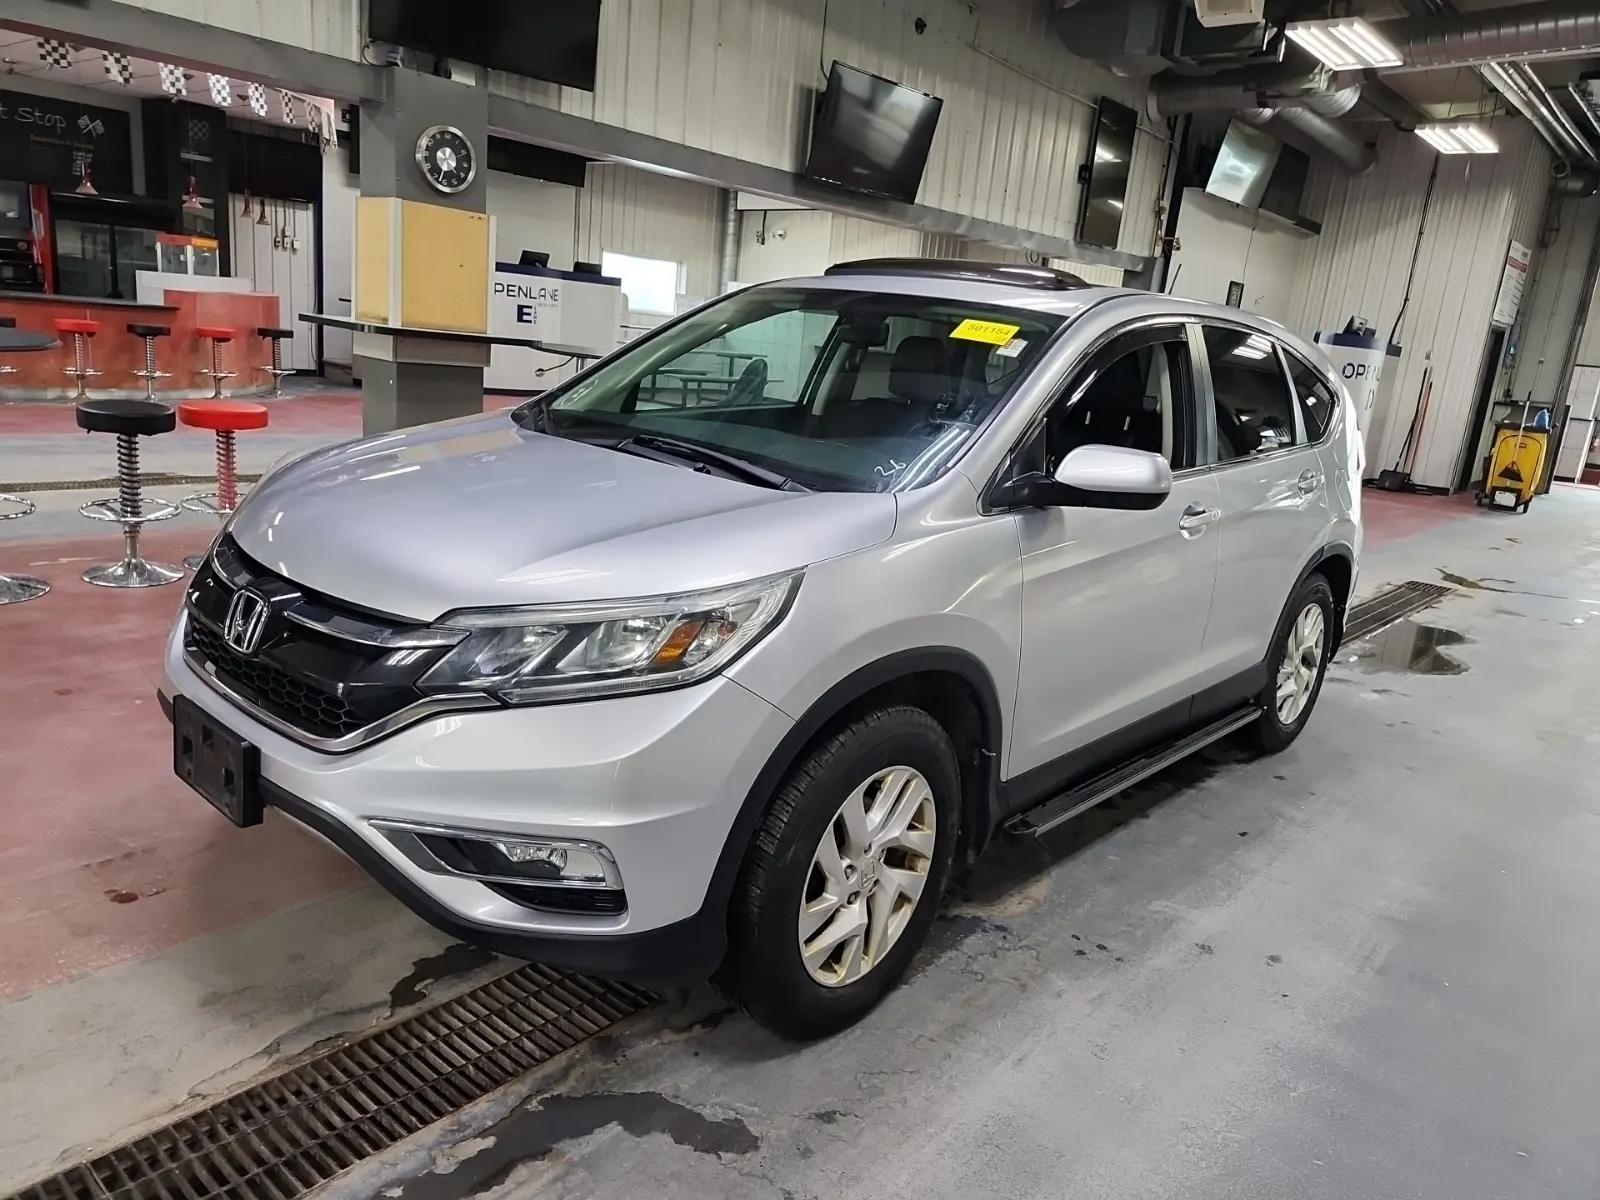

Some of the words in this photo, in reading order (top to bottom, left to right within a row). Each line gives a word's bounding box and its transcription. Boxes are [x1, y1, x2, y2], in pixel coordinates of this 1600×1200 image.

[14, 107, 66, 134] Stop
[516, 304, 533, 324] E
[968, 324, 1011, 335] 501154
